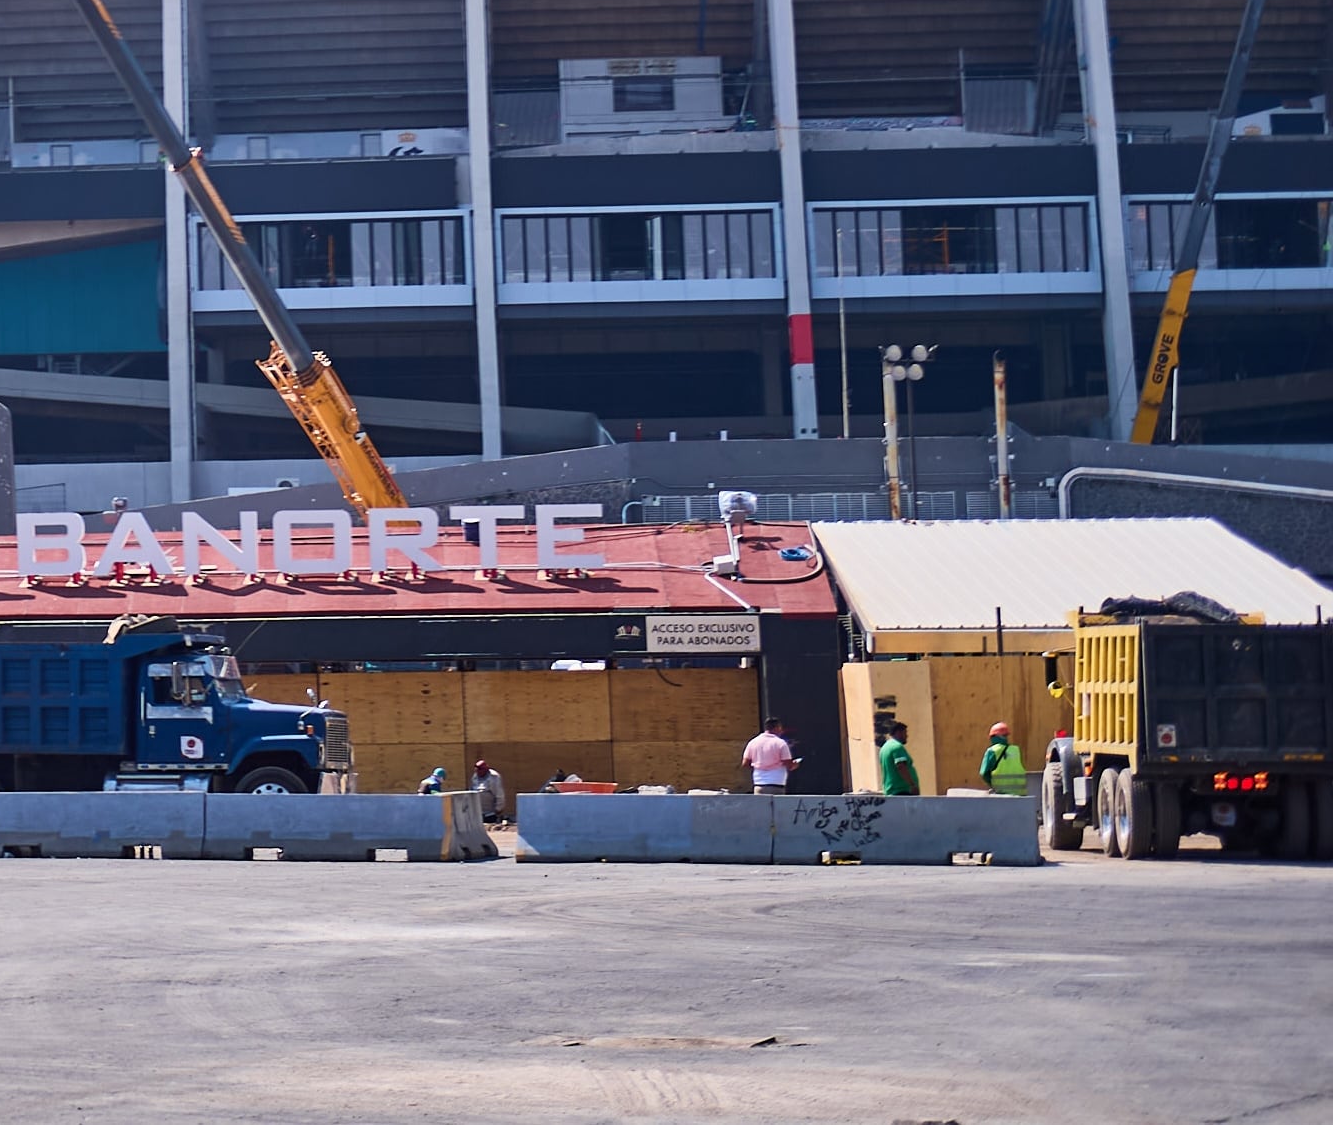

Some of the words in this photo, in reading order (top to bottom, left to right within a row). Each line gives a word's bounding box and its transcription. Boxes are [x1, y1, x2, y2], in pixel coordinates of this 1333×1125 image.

[1152, 333, 1174, 385] GROVE
[16, 504, 605, 575] BANORTE
[652, 623, 695, 634] ACCESO
[698, 623, 756, 634] EXCLUSIVO
[657, 635, 684, 646] PARA
[687, 635, 751, 646] ABONADOS
